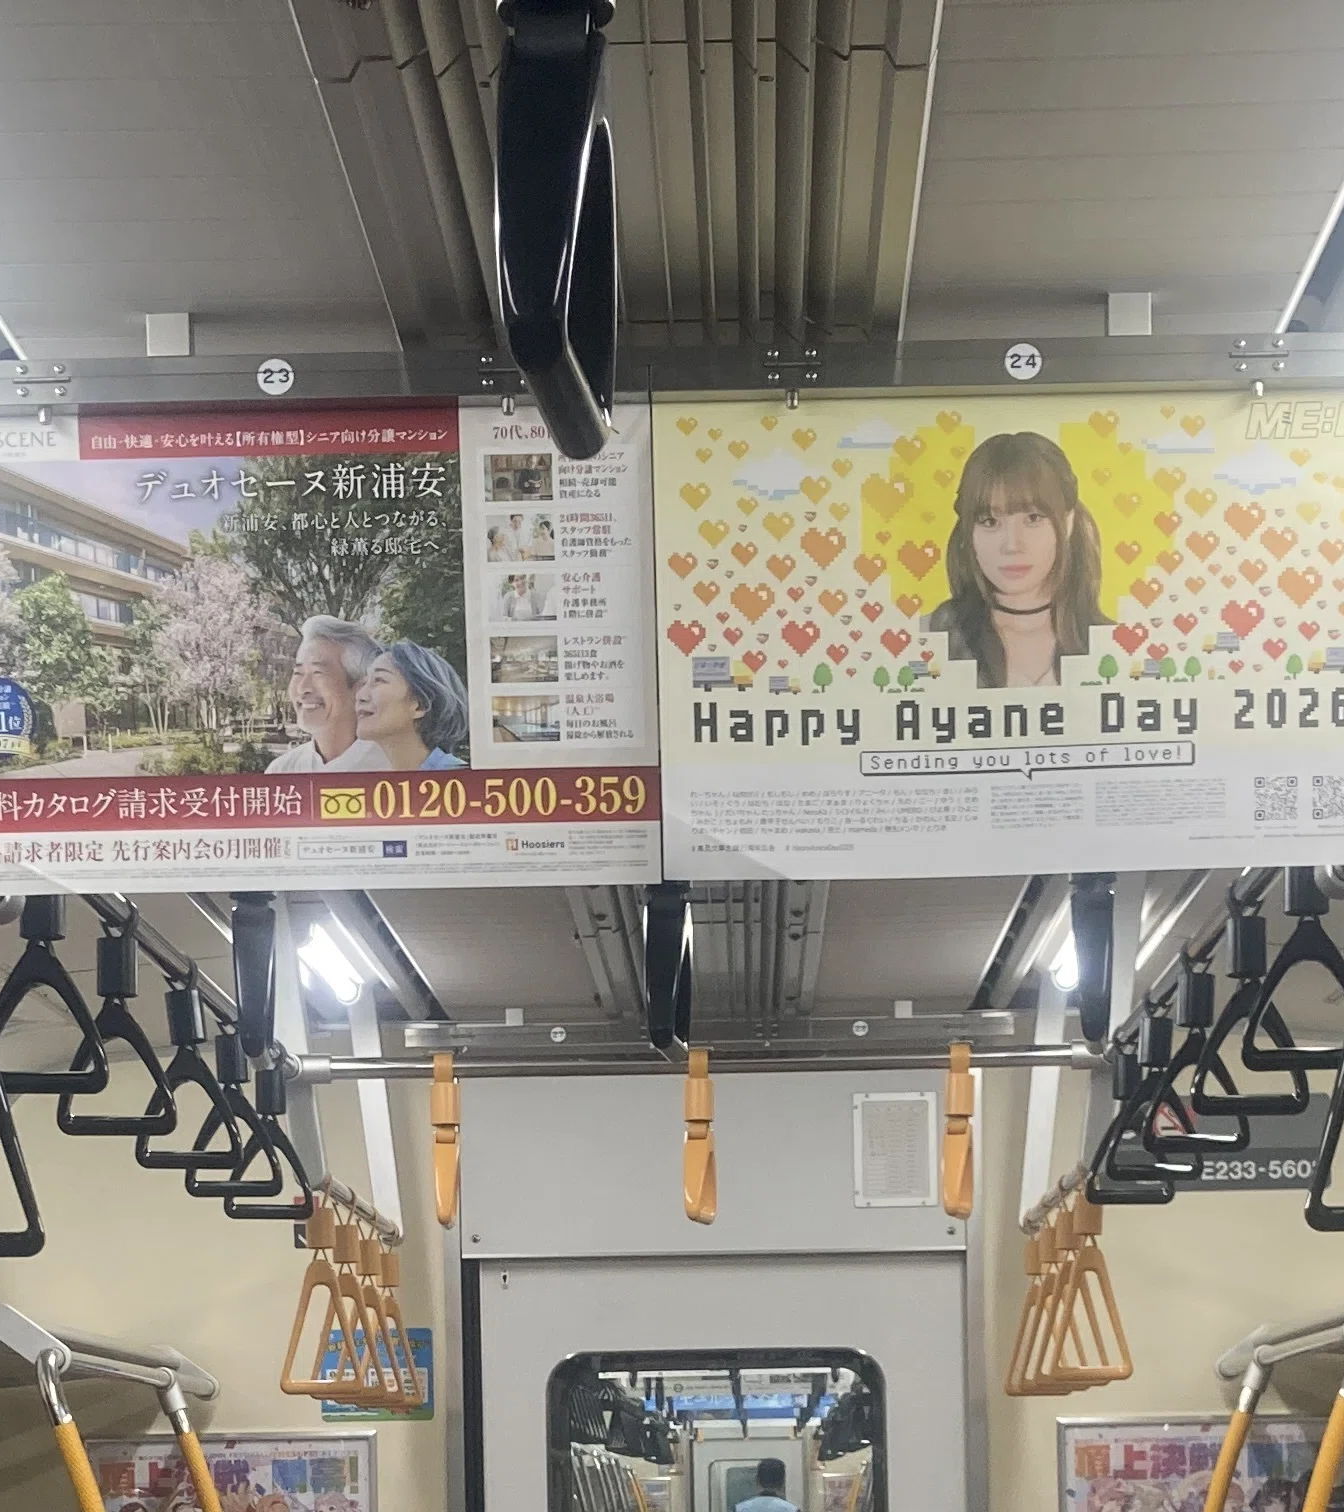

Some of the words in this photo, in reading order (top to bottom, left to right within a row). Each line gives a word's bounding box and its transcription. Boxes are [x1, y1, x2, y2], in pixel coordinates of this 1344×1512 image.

[1010, 354, 1037, 369] 24
[261, 368, 290, 384] 23
[492, 425, 551, 440] 70代、80
[135, 462, 447, 501] デュオセーヌ新浦安
[222, 510, 448, 532] 新浦安、都心と人とつながる、
[693, 701, 860, 746] Happy
[896, 699, 1064, 744] Ayane
[1100, 692, 1198, 735] Day
[870, 754, 958, 770] Sending
[972, 754, 1011, 769] you
[1024, 750, 1071, 766] lots
[1085, 748, 1109, 764] of
[1123, 745, 1183, 762] love!
[372, 775, 647, 819] 0120-500-359
[111, 836, 282, 862] 先行案内会6月開催
[521, 838, 565, 850] Hoosiers
